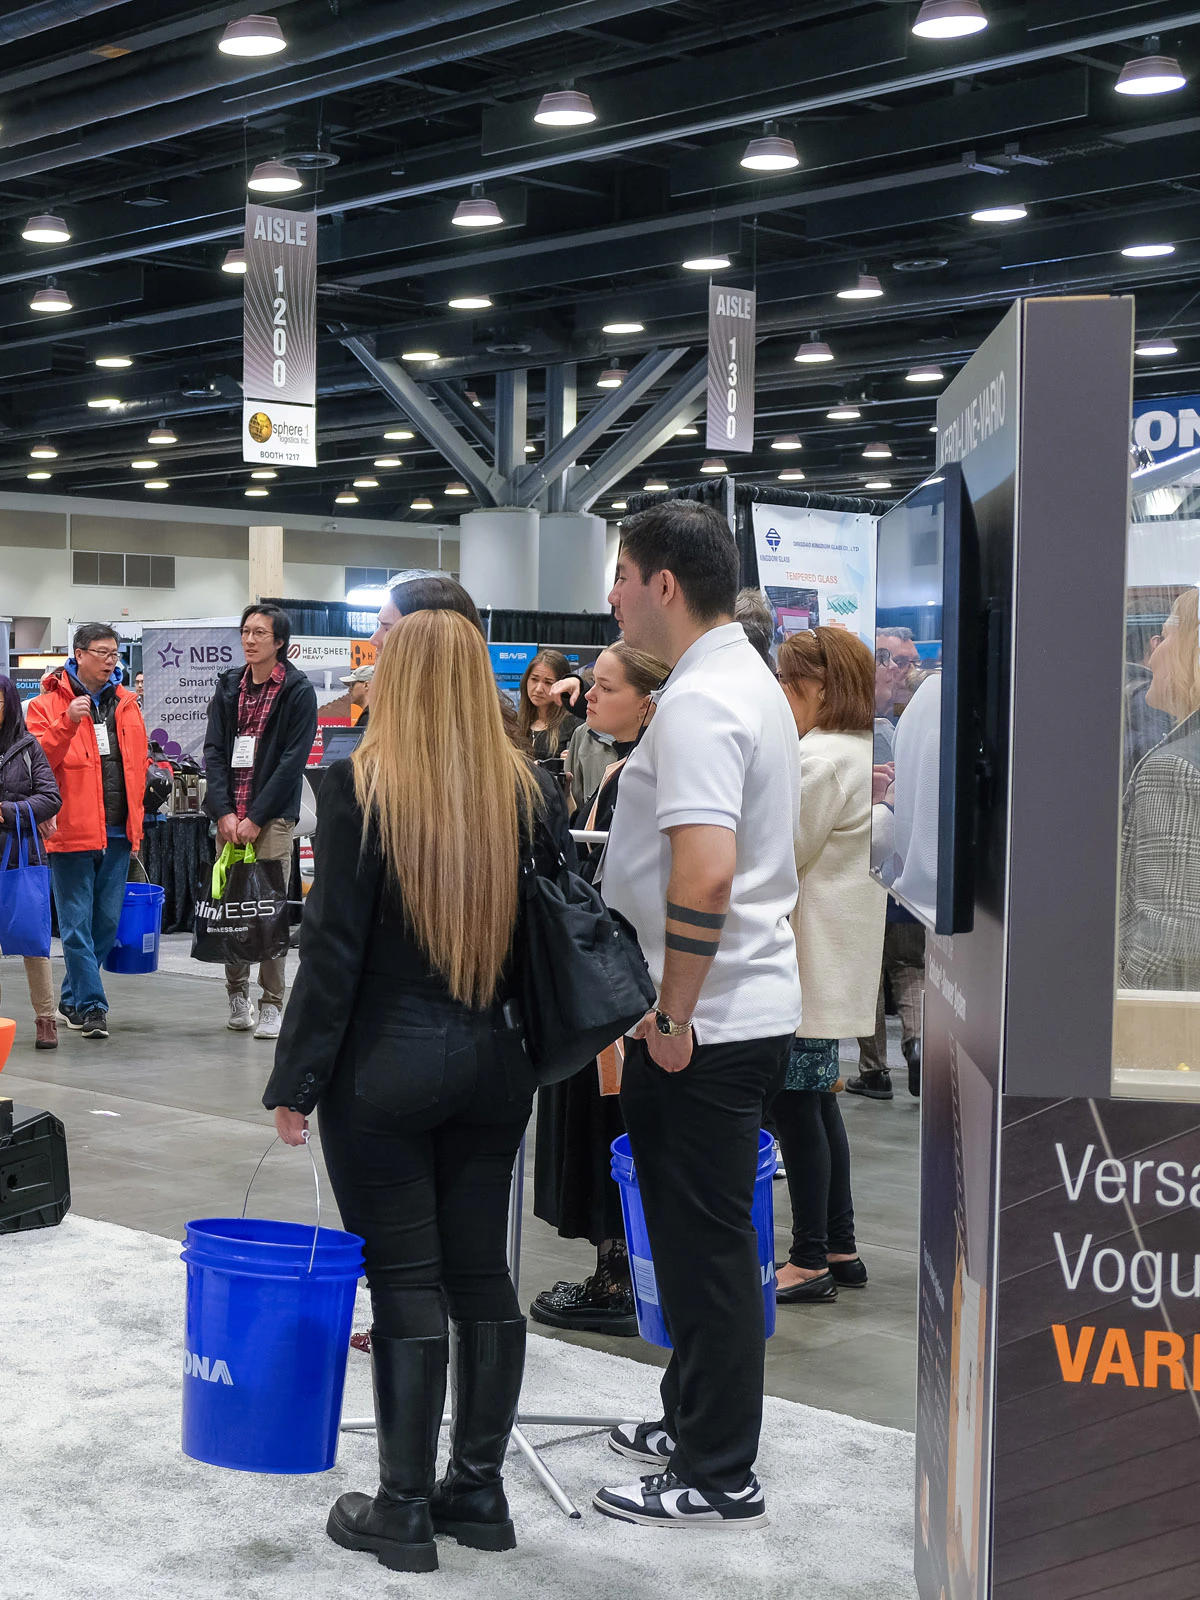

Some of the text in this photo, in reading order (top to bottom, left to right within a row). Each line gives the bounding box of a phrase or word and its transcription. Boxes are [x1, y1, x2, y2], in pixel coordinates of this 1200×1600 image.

[254, 215, 307, 246] AISLE
[716, 294, 751, 319] AISLE
[273, 265, 287, 388] 1200
[726, 336, 737, 439] 1300
[272, 421, 303, 437] sphere
[280, 435, 300, 445] logistics
[260, 451, 300, 461] BOOTH 1217
[786, 571, 838, 584] TEMPERED GLASS
[190, 646, 232, 663] NBS
[160, 711, 207, 723] specific
[1053, 1232, 1200, 1309] Vogu
